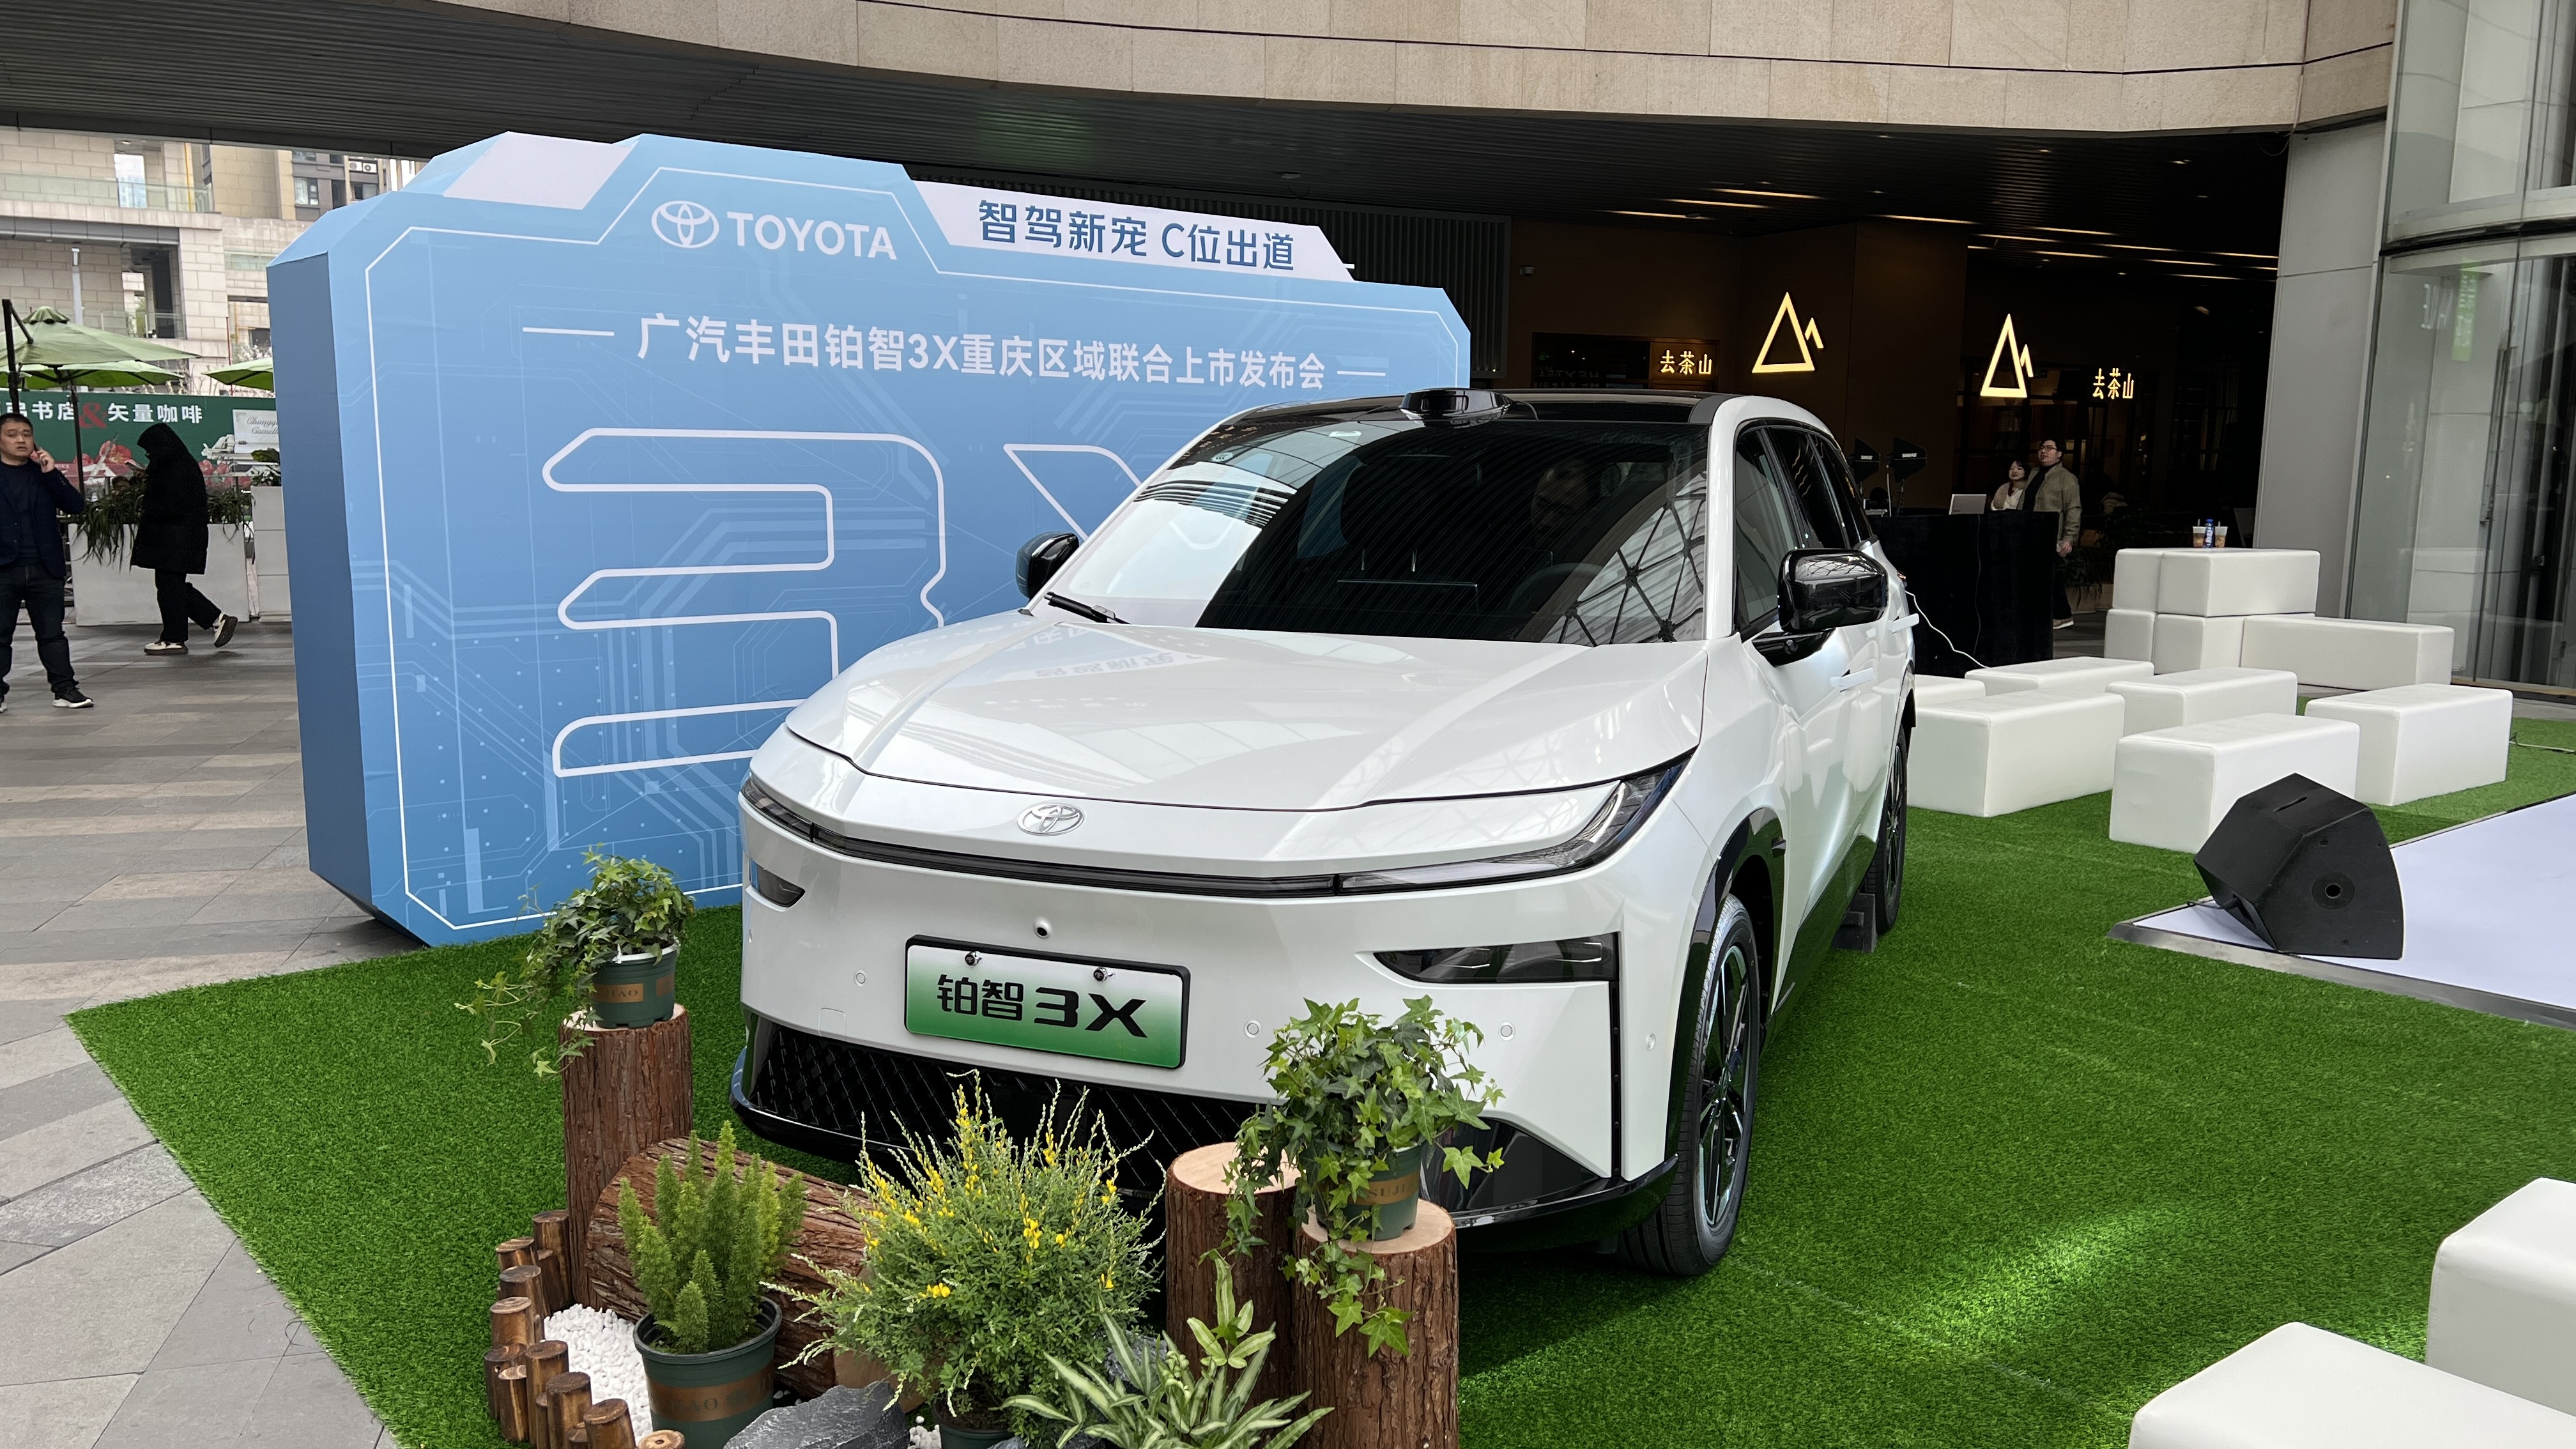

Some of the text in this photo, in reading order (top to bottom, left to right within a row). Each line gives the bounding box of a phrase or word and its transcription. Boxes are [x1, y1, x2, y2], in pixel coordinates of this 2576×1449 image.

[727, 211, 897, 260] TOYOTA
[979, 200, 1294, 270] 智驾新宠 C位出道
[637, 312, 1325, 390] 广汽丰田铂智3X重庆区域联合上市发布会
[1660, 350, 1712, 375] 去茶山
[2092, 367, 2135, 399] 去茶山
